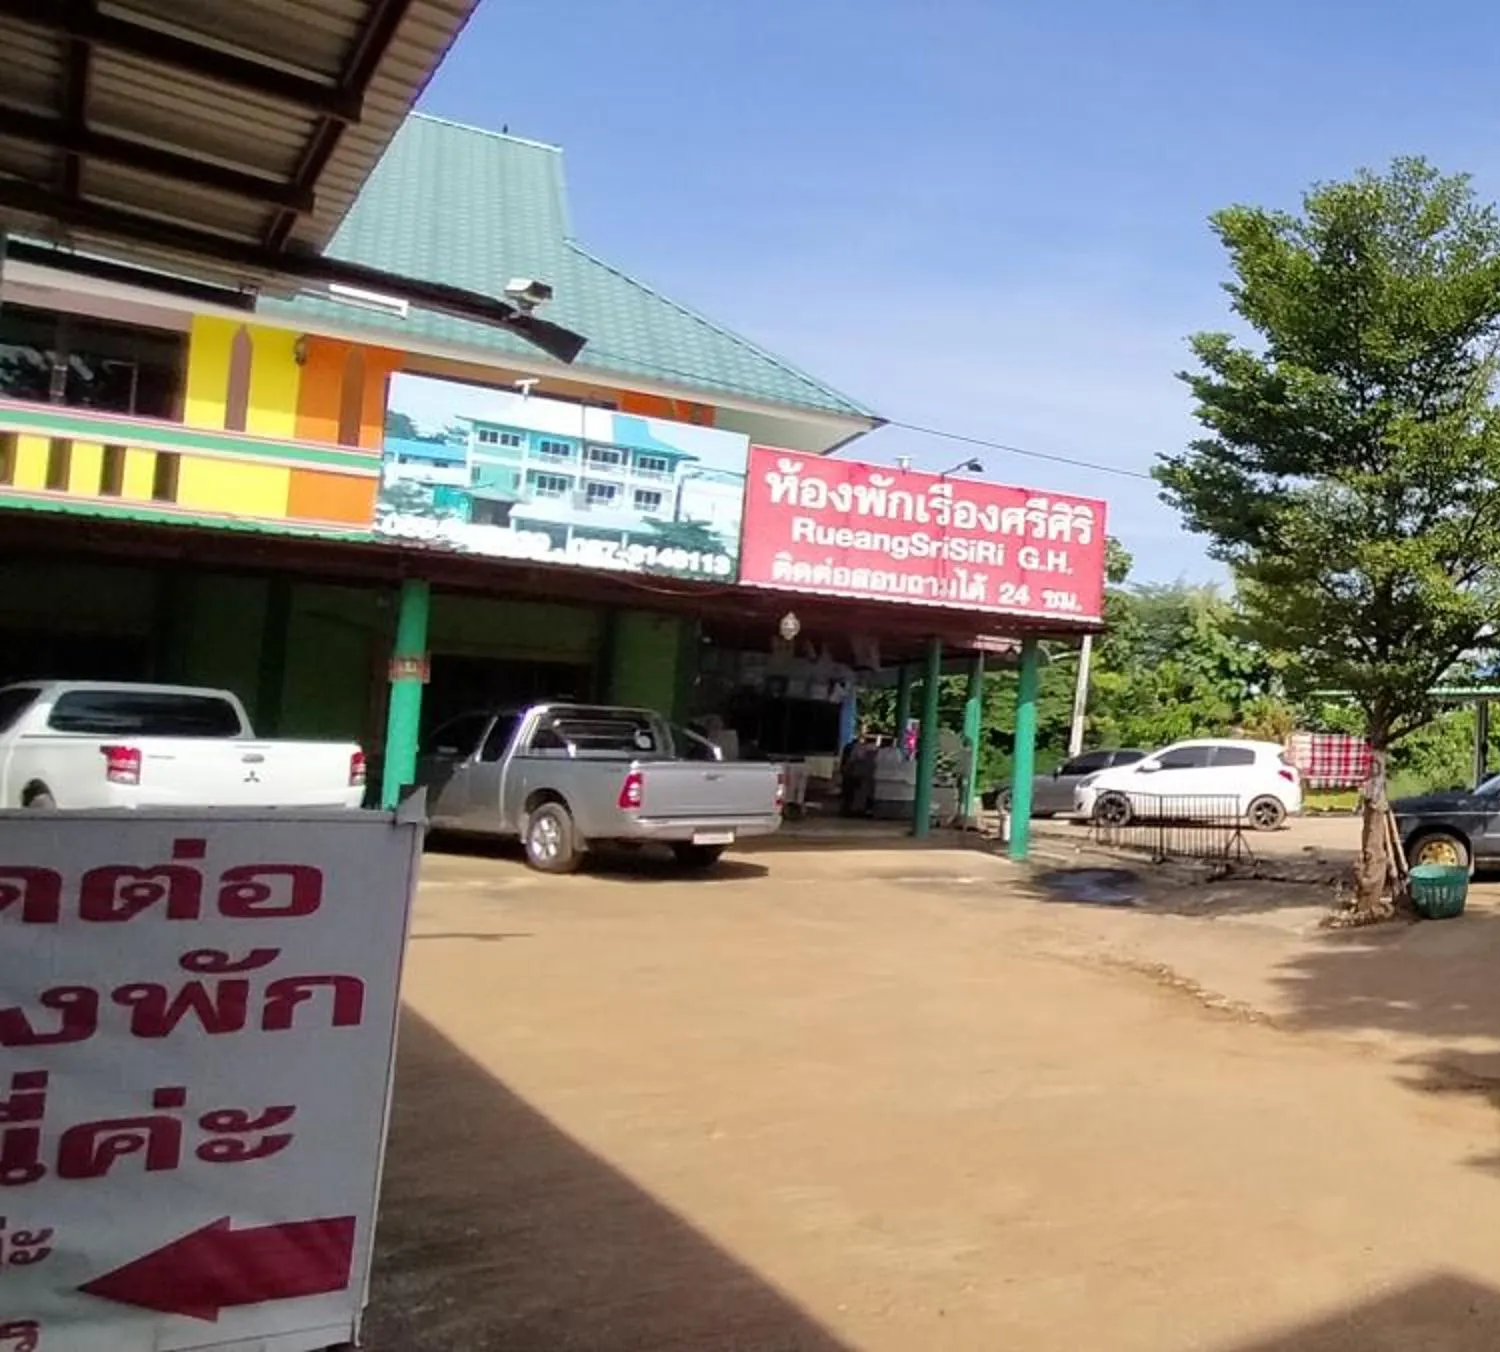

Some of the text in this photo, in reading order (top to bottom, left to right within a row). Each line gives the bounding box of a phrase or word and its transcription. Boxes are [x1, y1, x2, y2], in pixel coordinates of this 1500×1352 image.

[791, 516, 1074, 575] RueangSriSiRi G.H.
[998, 583, 1030, 606] 24
